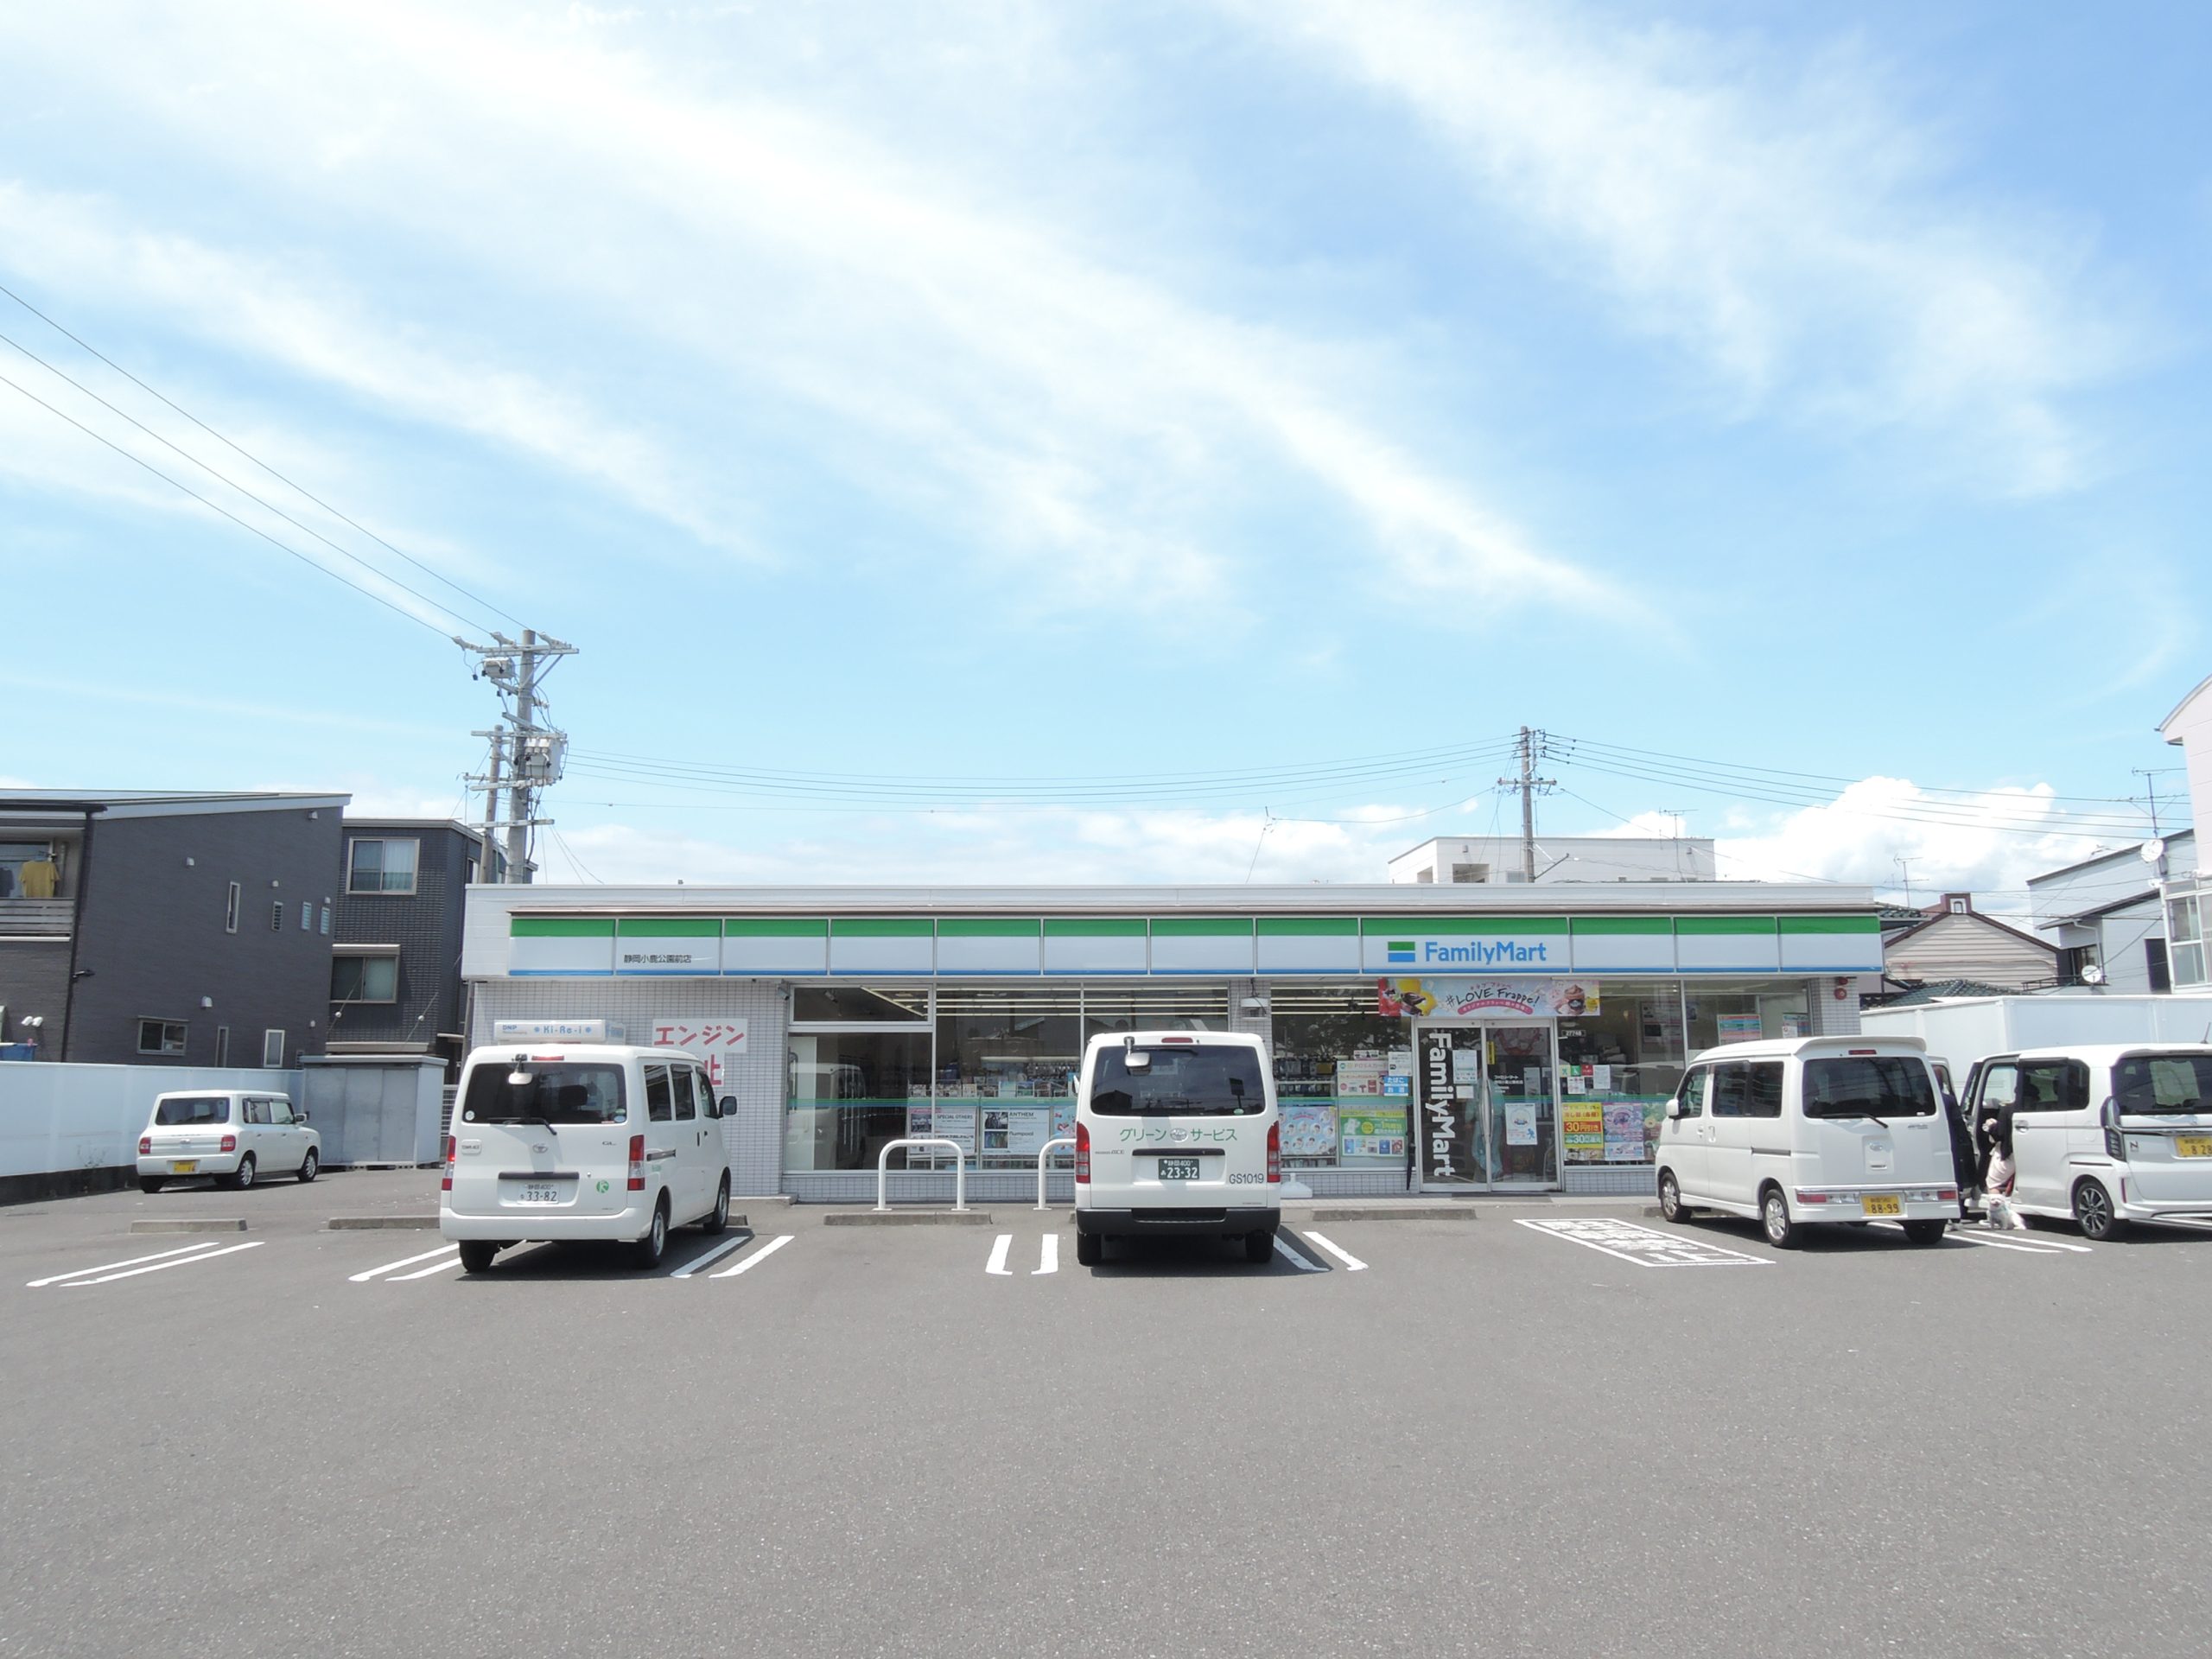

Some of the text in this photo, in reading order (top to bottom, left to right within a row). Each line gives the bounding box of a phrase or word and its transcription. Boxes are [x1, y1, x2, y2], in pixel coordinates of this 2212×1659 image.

[624, 954, 692, 963] 静岡小鹿公園前店
[1425, 941, 1547, 965] FamilyMart
[1446, 988, 1494, 1007] #LOVE
[654, 1025, 745, 1046] エンジン
[1425, 1033, 1456, 1177] FamilyMart
[1120, 1128, 1237, 1141] グリーン サービス
[1167, 1167, 1198, 1179] 23-32
[1229, 1173, 1264, 1185] GS1019
[526, 1191, 557, 1202] 33-82
